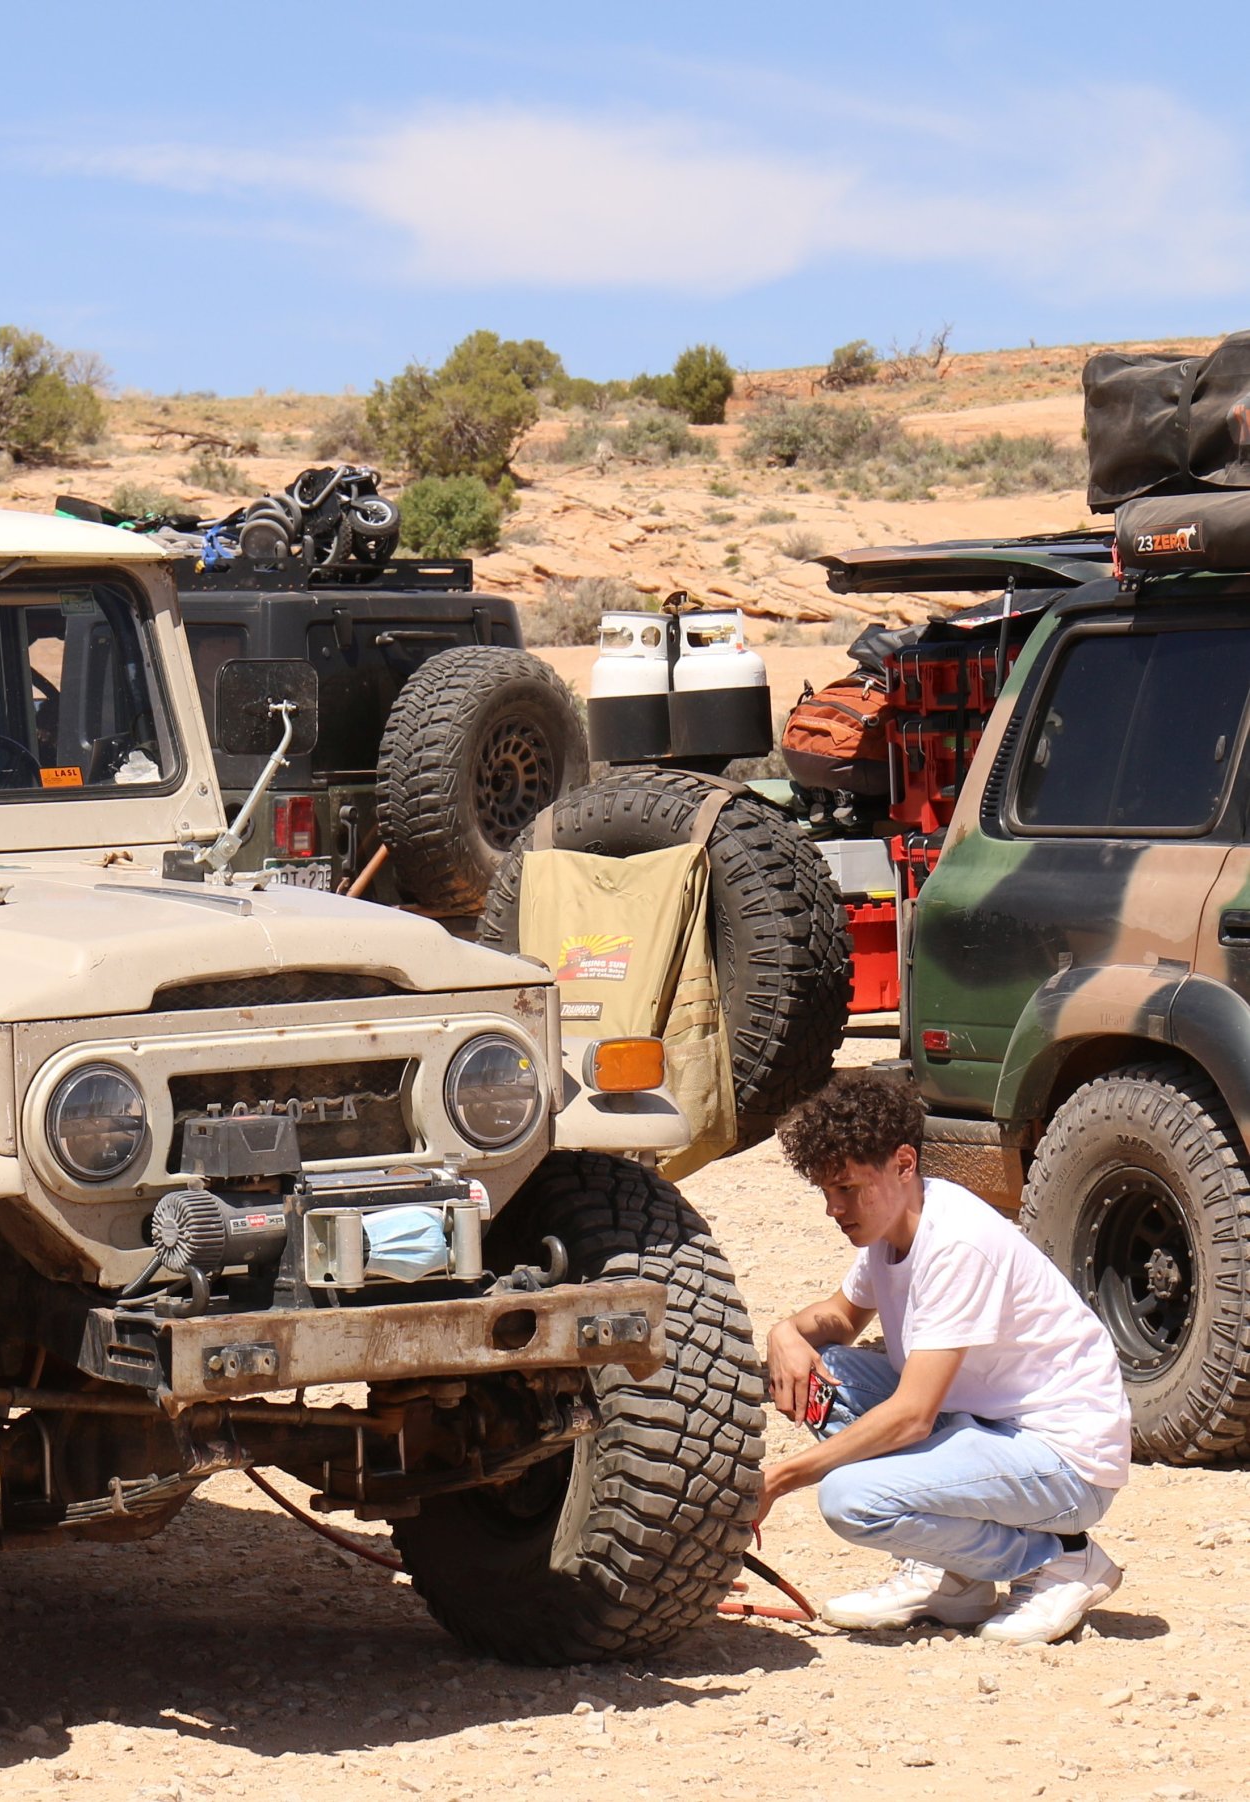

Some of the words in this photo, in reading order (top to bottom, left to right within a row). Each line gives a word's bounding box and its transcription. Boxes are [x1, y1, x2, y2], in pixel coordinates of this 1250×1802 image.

[1137, 533, 1188, 552] 23ZERO
[579, 960, 607, 968] RISING
[608, 961, 627, 969] SUN
[206, 1095, 358, 1122] TOYOTA
